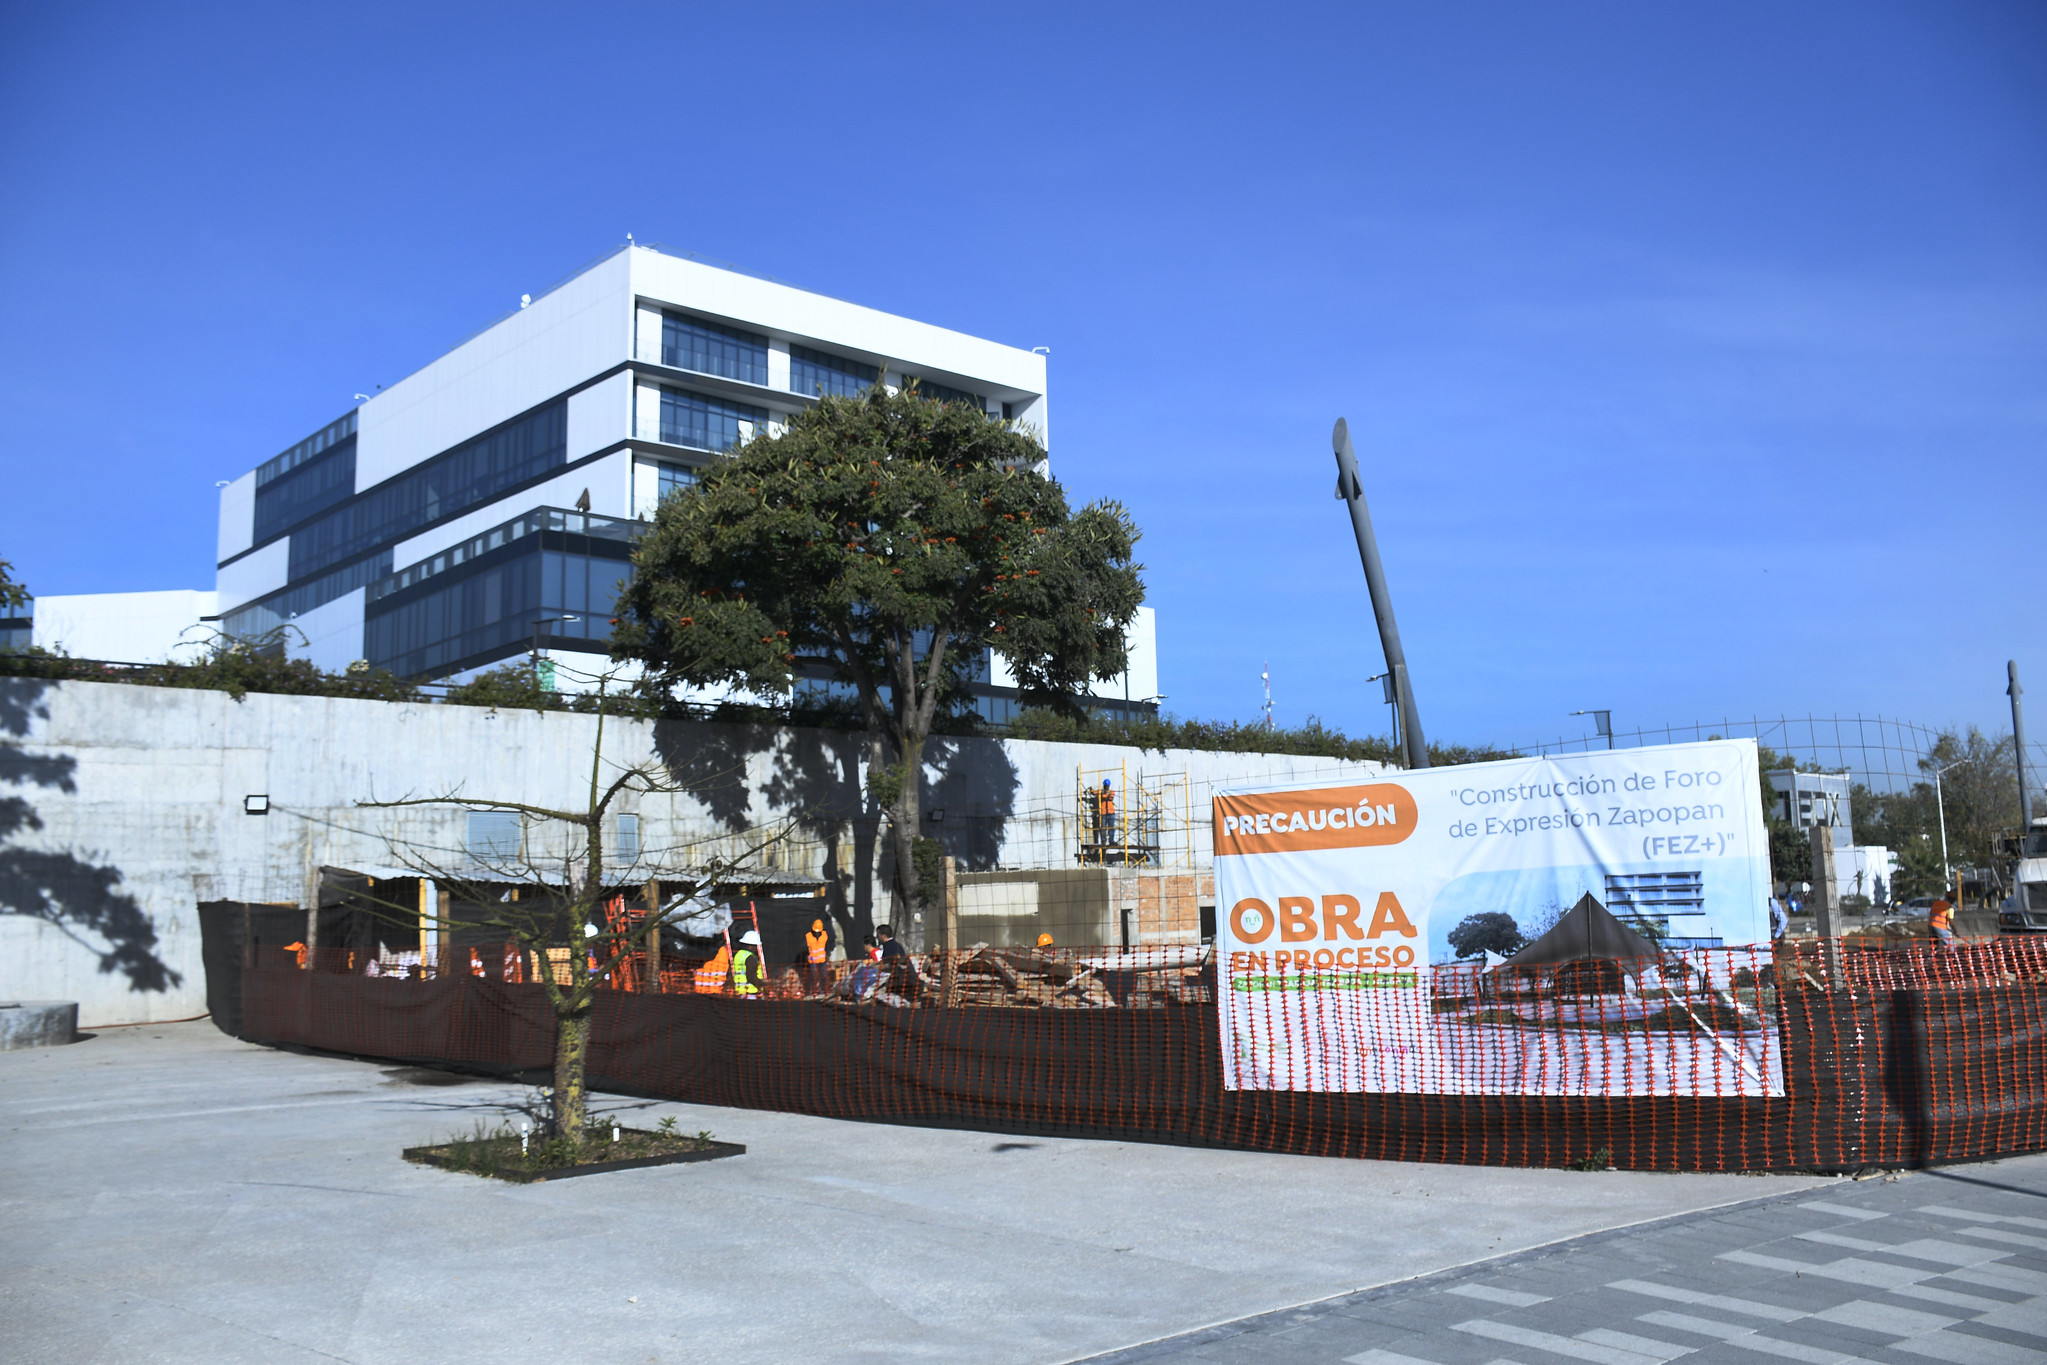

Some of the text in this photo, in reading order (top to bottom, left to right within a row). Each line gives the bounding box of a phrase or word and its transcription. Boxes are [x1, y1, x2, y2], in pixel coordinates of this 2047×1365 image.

[1450, 769, 1722, 806] "Construcción de Foro
[1223, 797, 1397, 837] PRECAUCIÓN
[1449, 803, 1725, 838] de Expresión Zapopan
[1642, 832, 1734, 860] (FEZ+)"
[1230, 891, 1418, 944] OBRA
[1232, 945, 1415, 972] EN PROCESO
